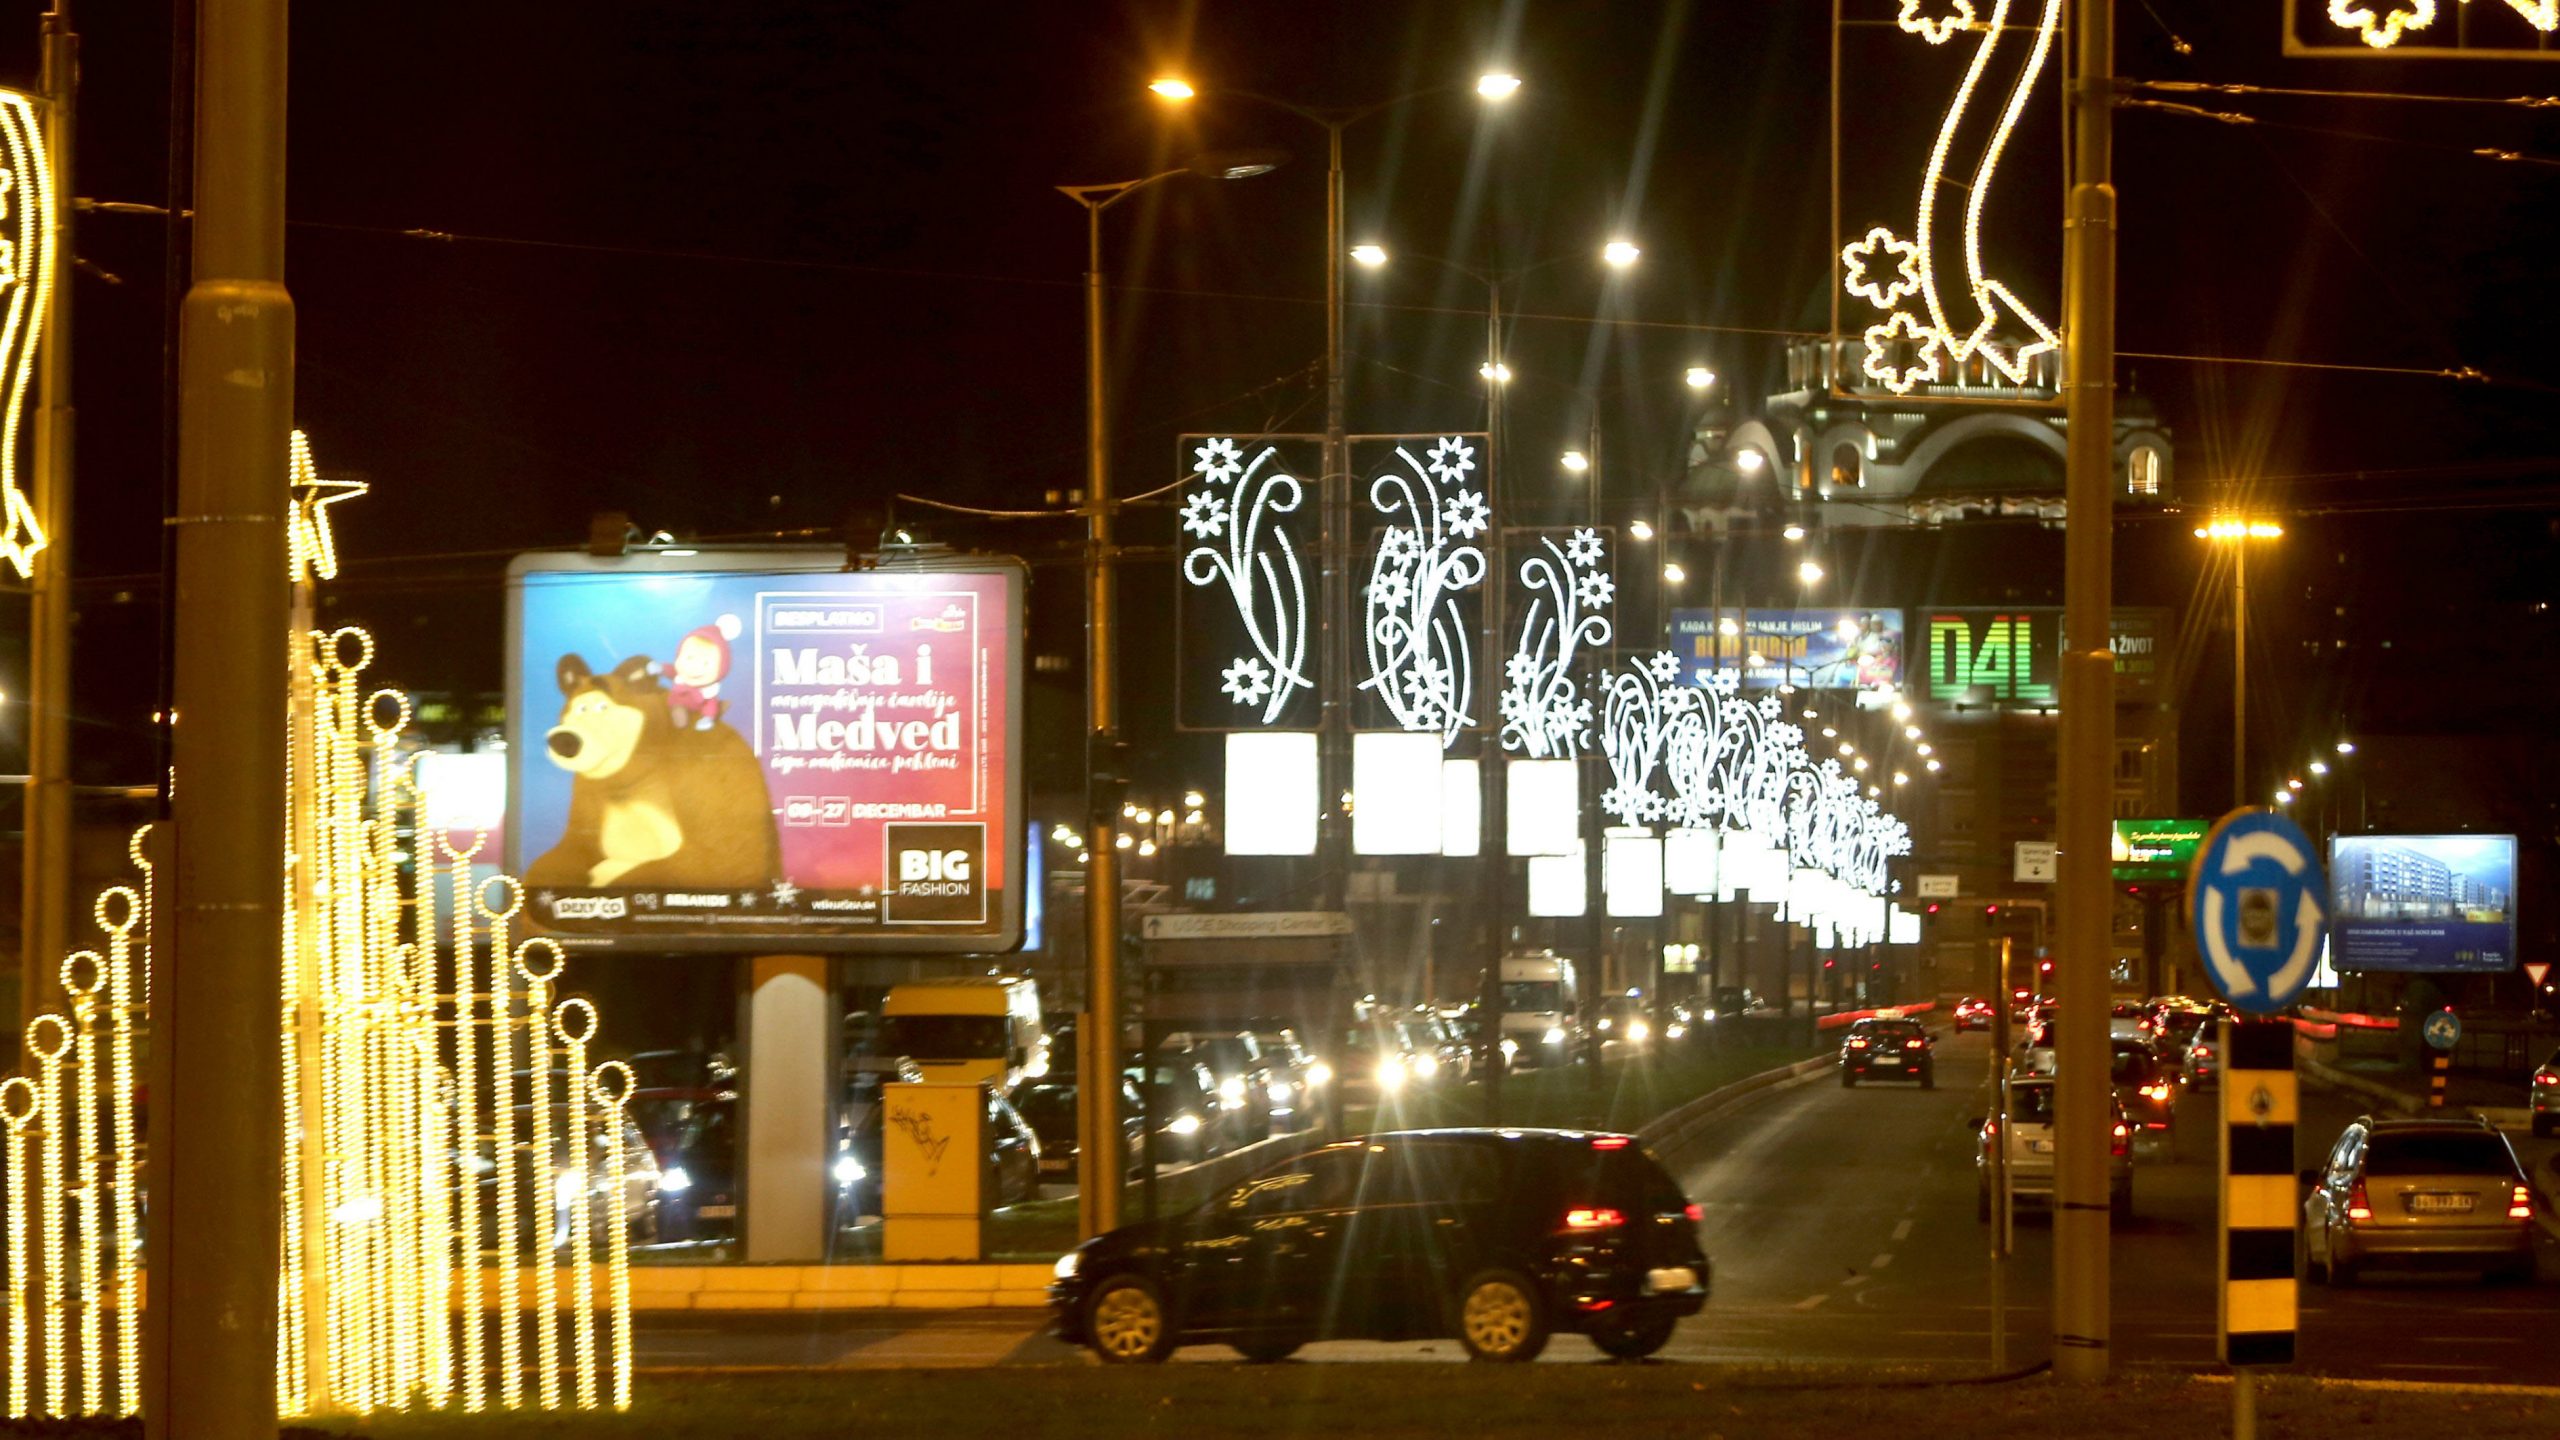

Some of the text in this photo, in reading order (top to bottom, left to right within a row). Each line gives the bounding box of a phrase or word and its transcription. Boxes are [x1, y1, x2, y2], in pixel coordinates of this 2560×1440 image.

[2119, 635, 2154, 654] ŽIVOT
[771, 643, 934, 685] Maša i
[771, 711, 960, 751] Medved
[852, 803, 946, 819] DECEMBAR
[901, 849, 970, 881] BIG
[902, 882, 970, 896] FASHION
[560, 901, 621, 914] DEXY CO
[1217, 918, 1276, 933] Shopping
